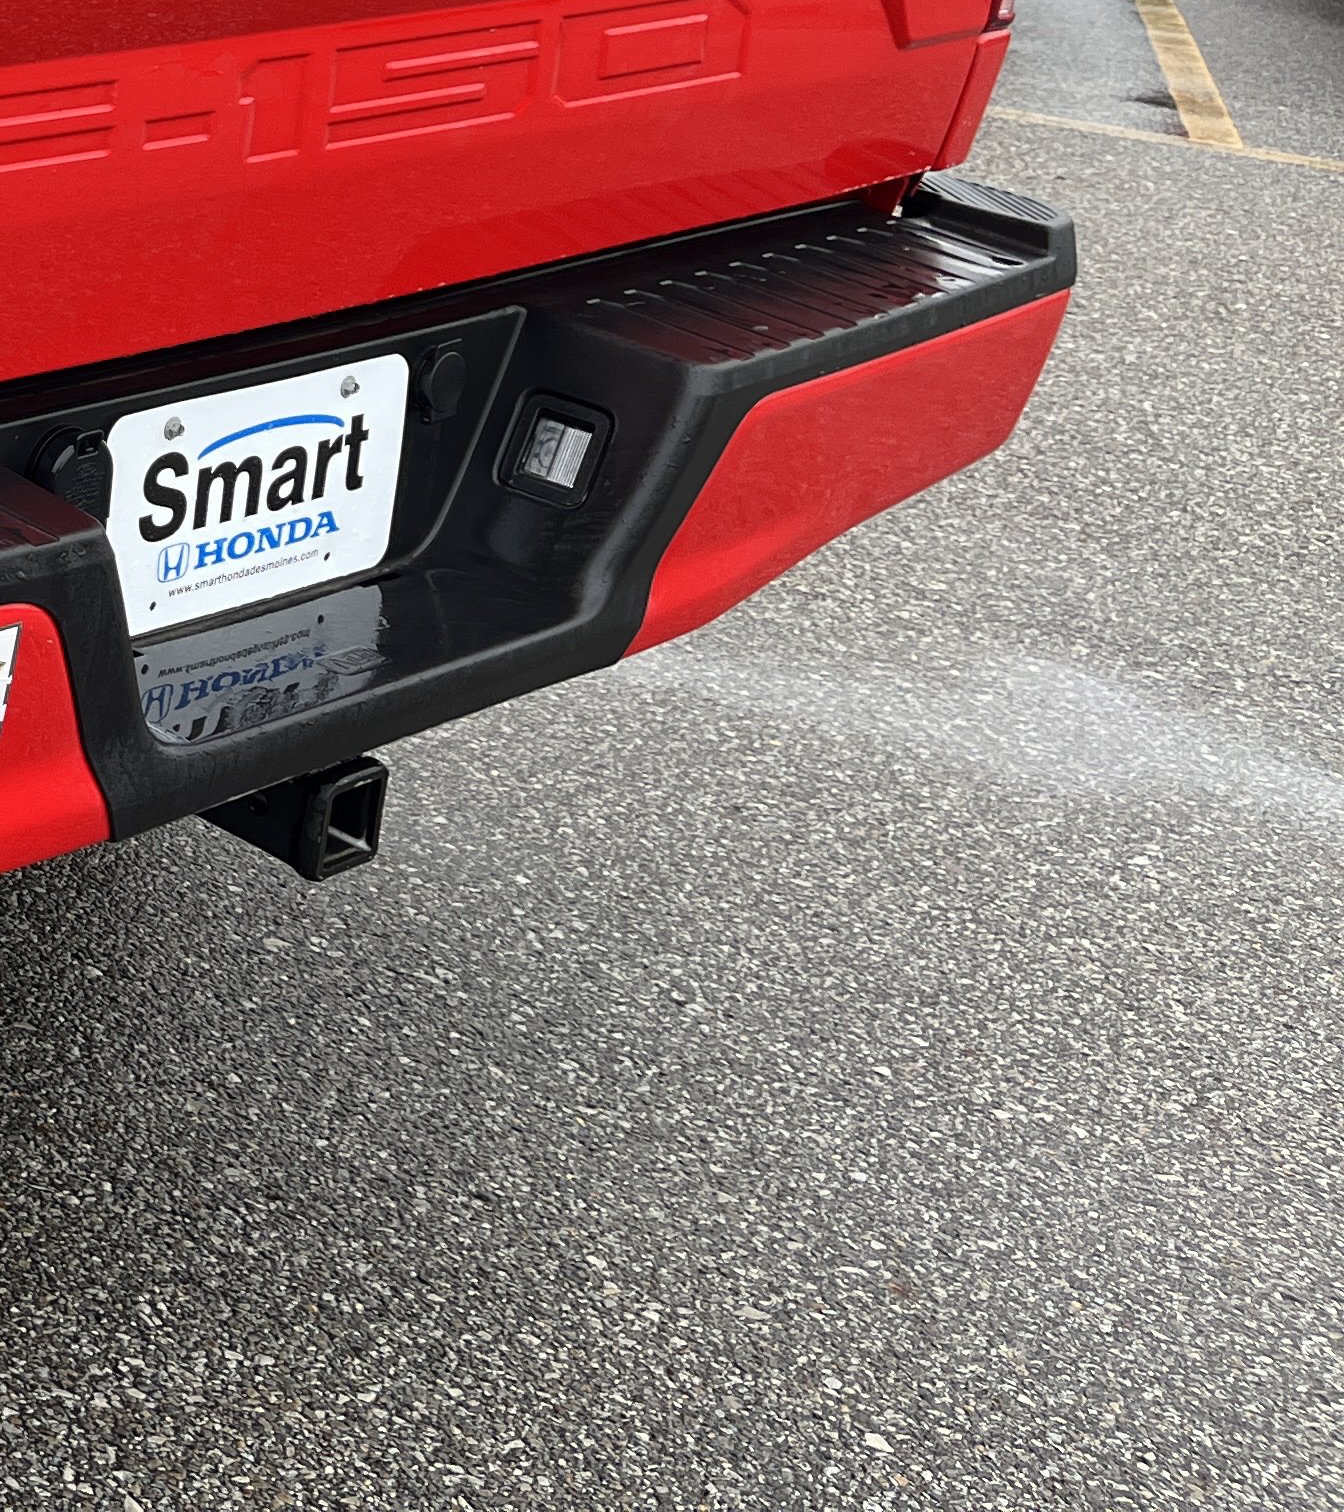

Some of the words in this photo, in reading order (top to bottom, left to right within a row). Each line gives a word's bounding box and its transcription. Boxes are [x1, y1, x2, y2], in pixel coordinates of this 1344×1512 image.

[138, 413, 369, 542] Smart
[193, 510, 340, 569] HONDA
[168, 548, 319, 598] www.smarthondadesmoines.com
